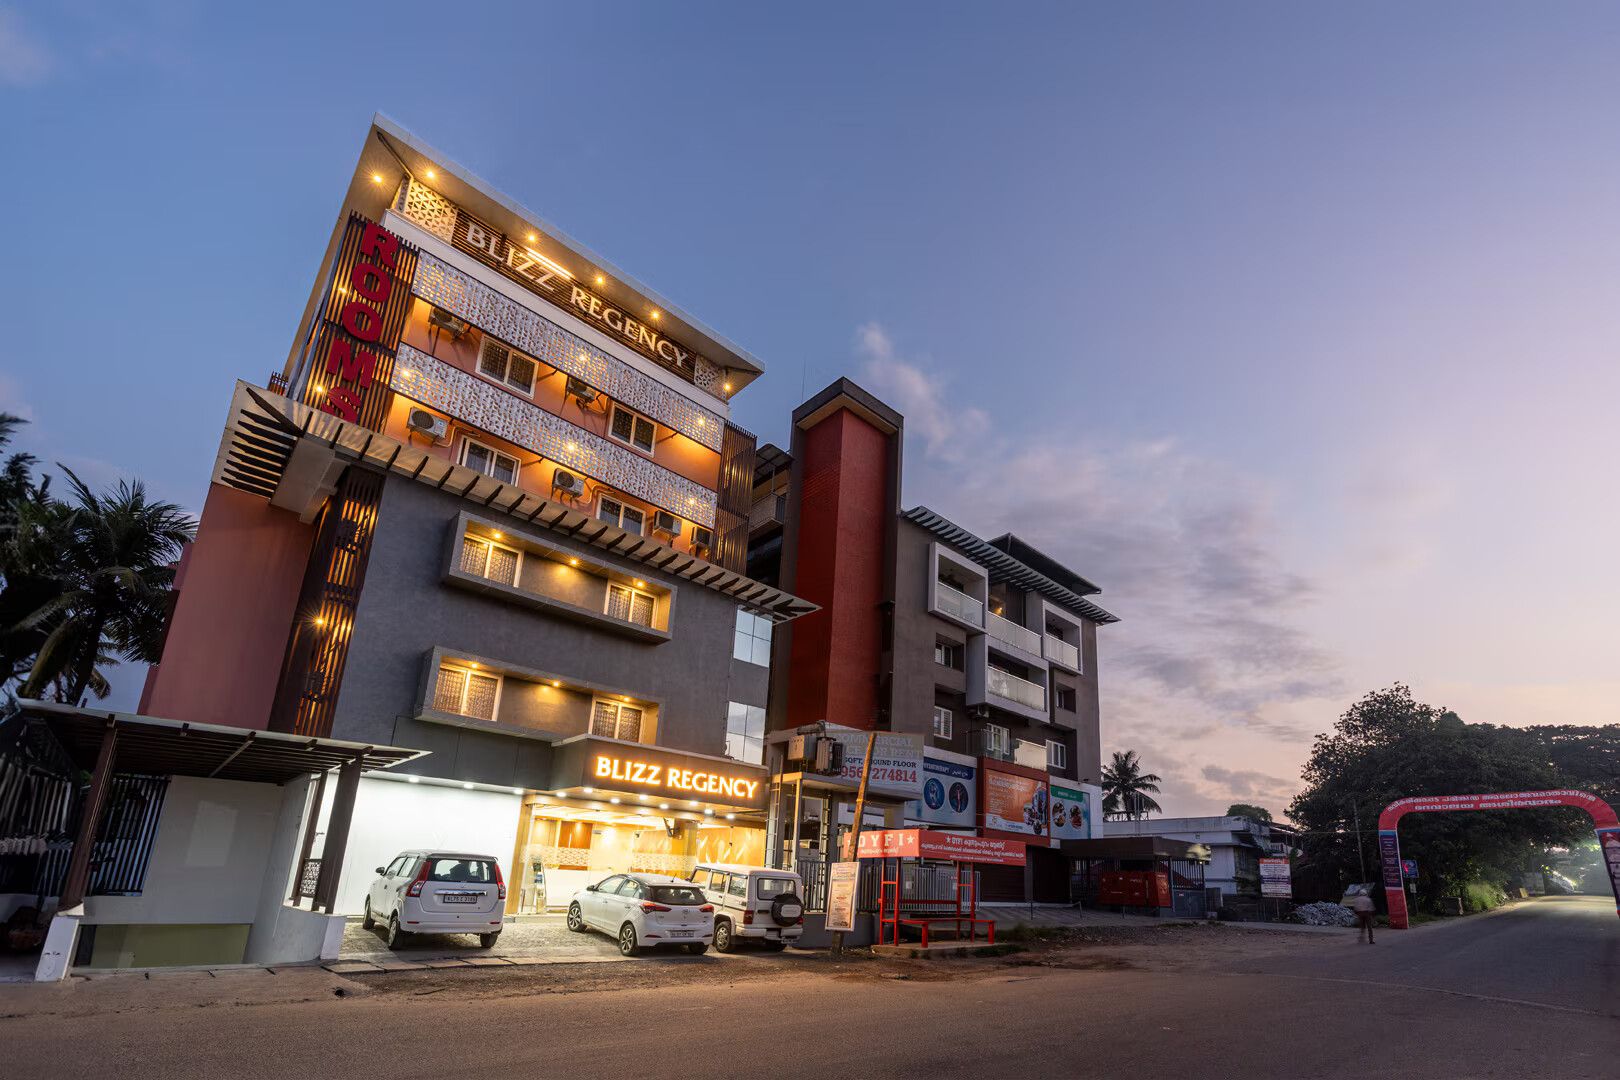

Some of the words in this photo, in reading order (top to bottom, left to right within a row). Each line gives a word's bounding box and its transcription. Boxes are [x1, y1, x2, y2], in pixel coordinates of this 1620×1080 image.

[465, 221, 556, 292] BLIZZ
[570, 285, 689, 369] REGENCY
[321, 221, 398, 423] ROOMS
[596, 755, 662, 785] BLIZZ
[666, 768, 758, 799] REGENCY
[841, 765, 917, 783] 956274814
[892, 760, 917, 768] FLOOR
